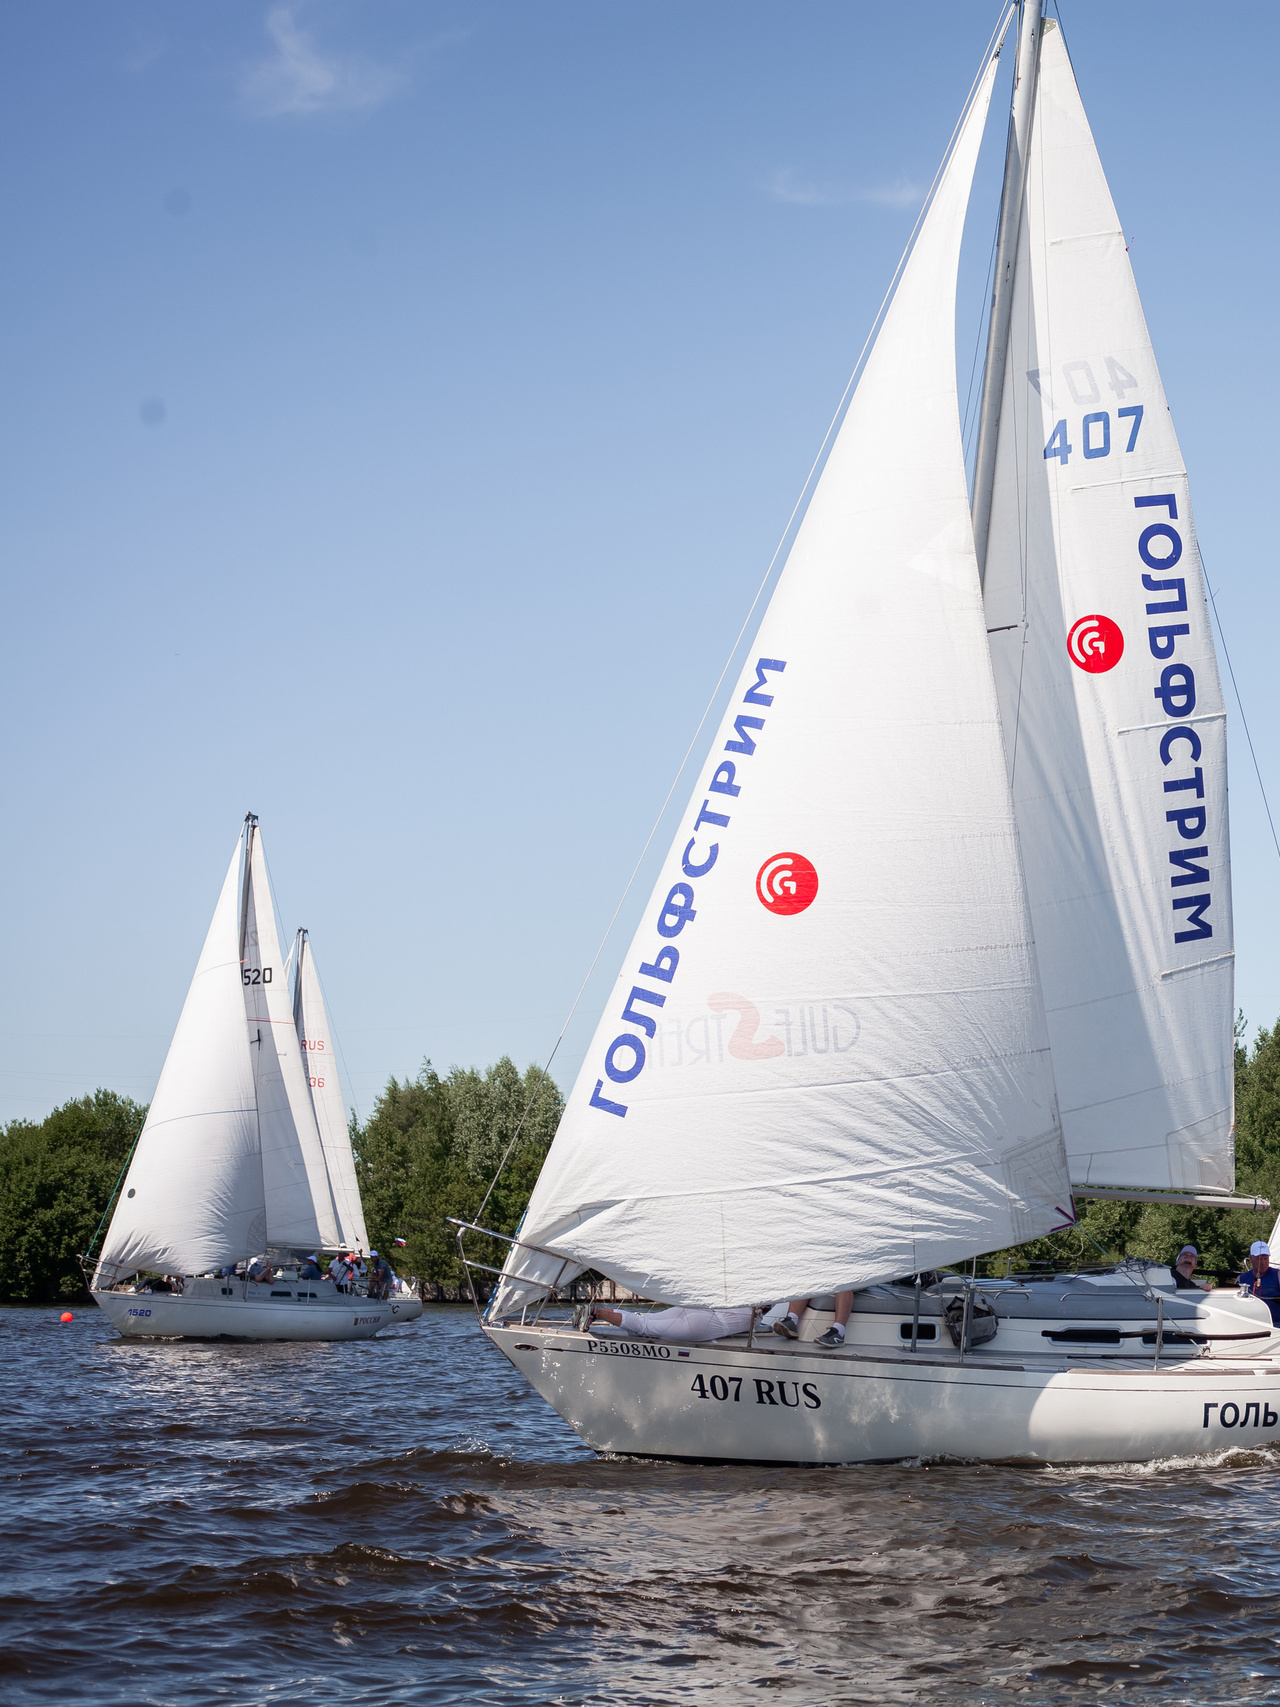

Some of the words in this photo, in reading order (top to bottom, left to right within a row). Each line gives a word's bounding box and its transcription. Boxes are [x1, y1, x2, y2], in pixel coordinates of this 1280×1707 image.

[1043, 405, 1143, 465] 407
[1134, 494, 1212, 943] ГОЛЬФСТРИМ
[589, 658, 786, 1118] ГОЛЬФСТРИМ
[301, 1040, 325, 1052] RUS
[309, 1077, 325, 1088] 36
[128, 1308, 152, 1317] 1520
[691, 1374, 742, 1402] 407
[753, 1379, 822, 1409] RUS
